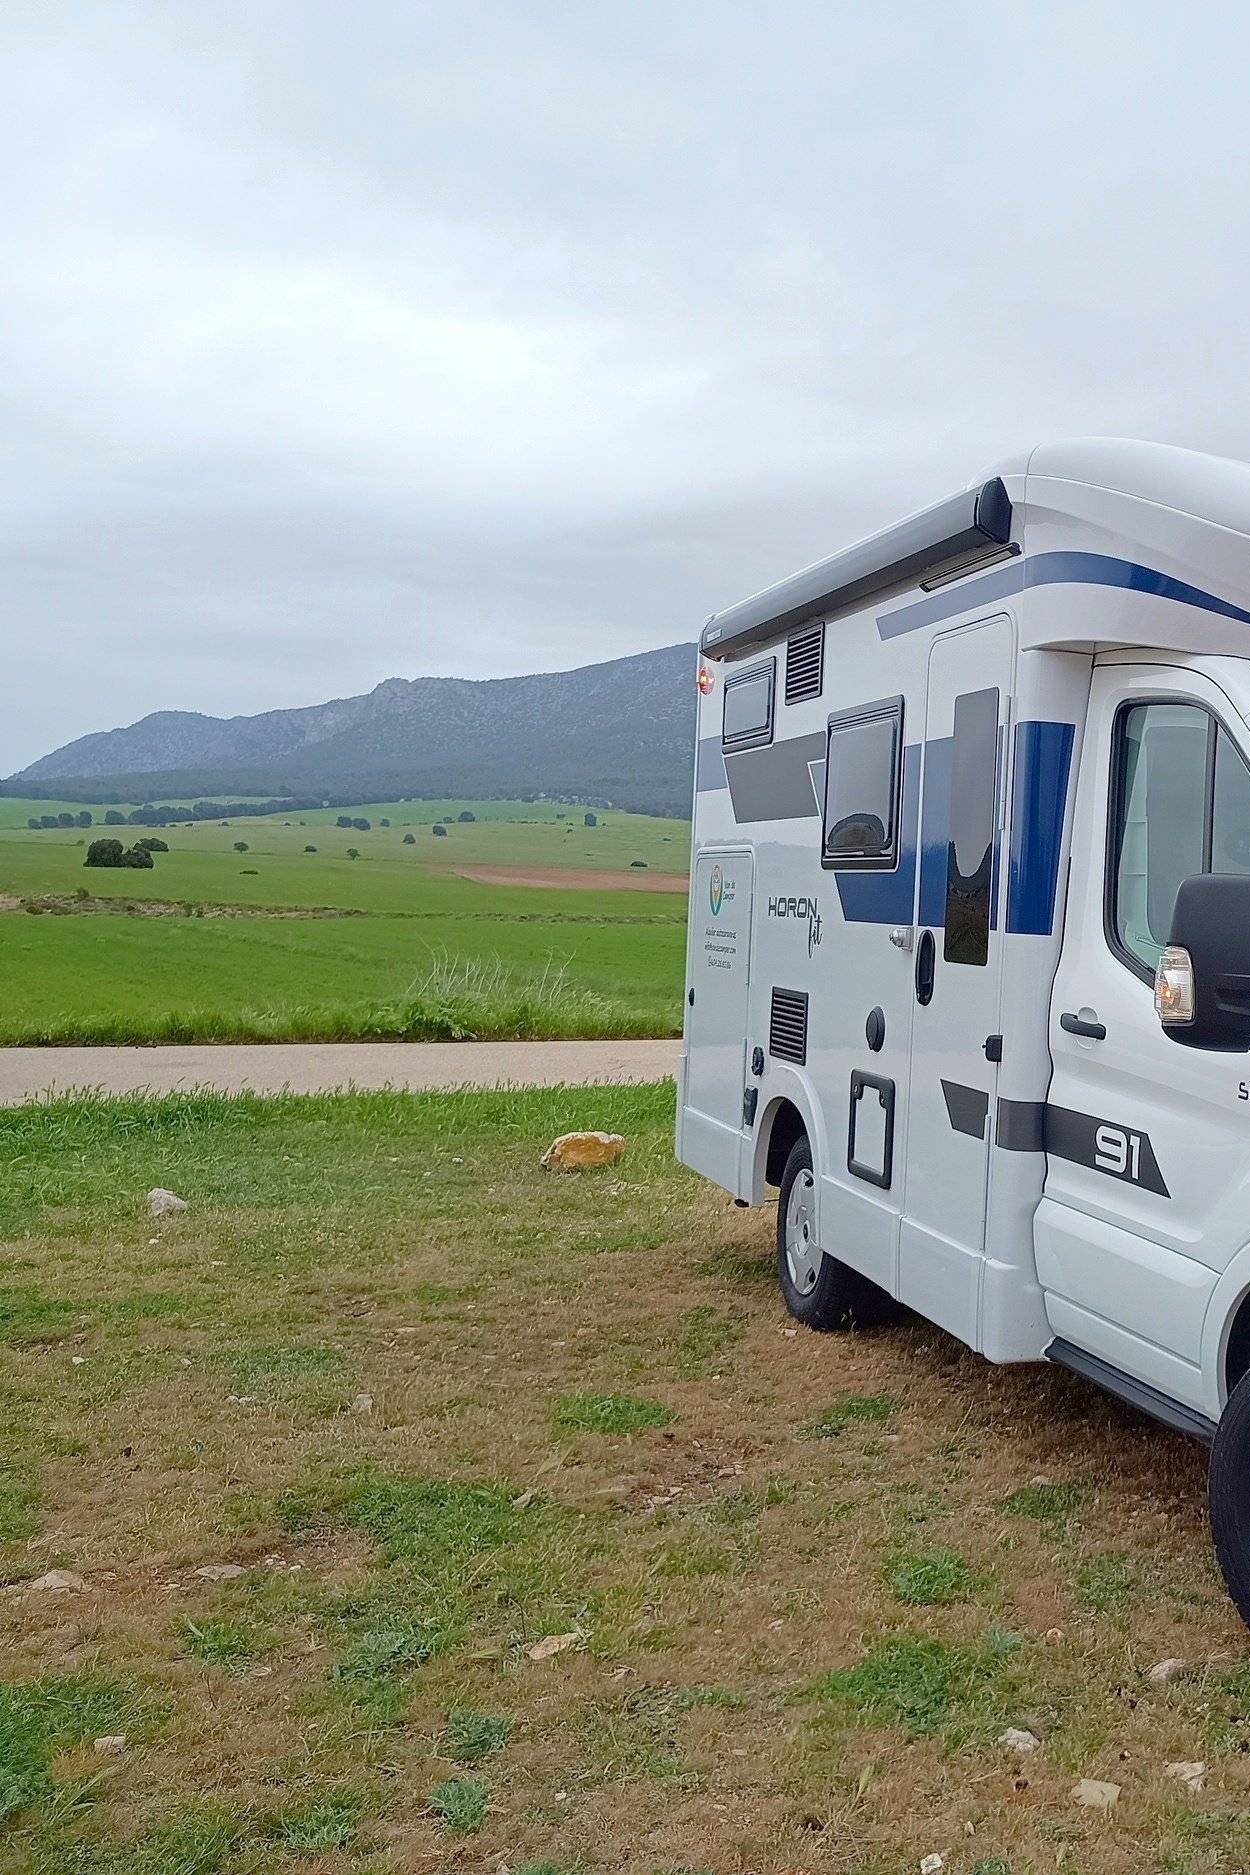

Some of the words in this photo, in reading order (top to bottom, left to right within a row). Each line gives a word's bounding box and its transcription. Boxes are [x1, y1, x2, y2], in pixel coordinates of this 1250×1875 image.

[767, 896, 818, 919] HORON
[808, 914, 823, 959] fit
[1094, 1124, 1141, 1180] 91
